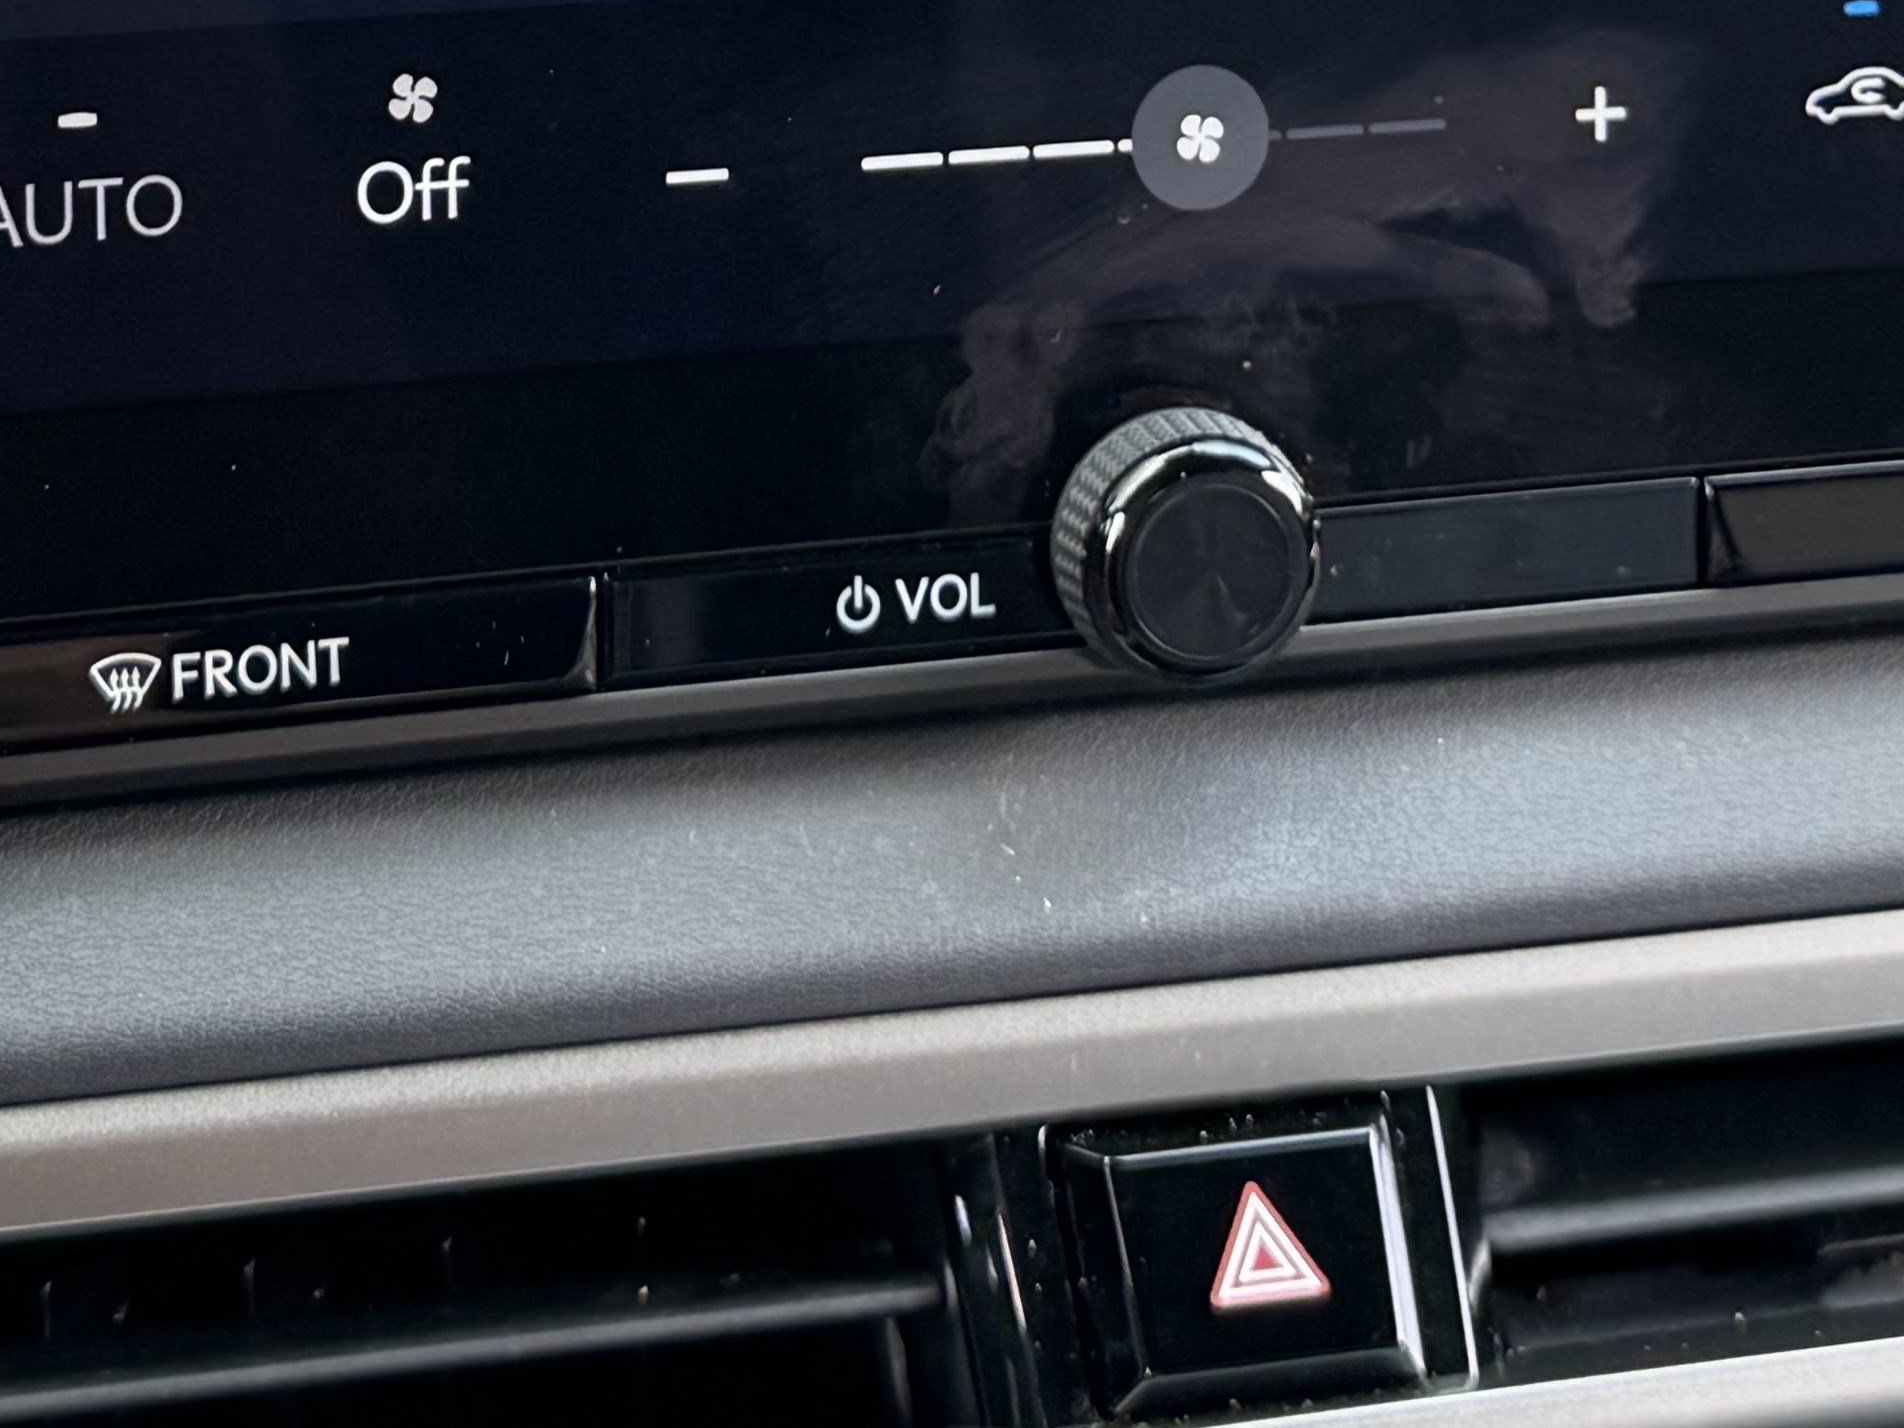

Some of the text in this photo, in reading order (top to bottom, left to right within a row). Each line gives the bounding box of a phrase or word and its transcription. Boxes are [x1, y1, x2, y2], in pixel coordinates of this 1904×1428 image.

[356, 154, 472, 225] Off
[894, 571, 997, 623] VOL
[171, 635, 351, 701] FRONT
